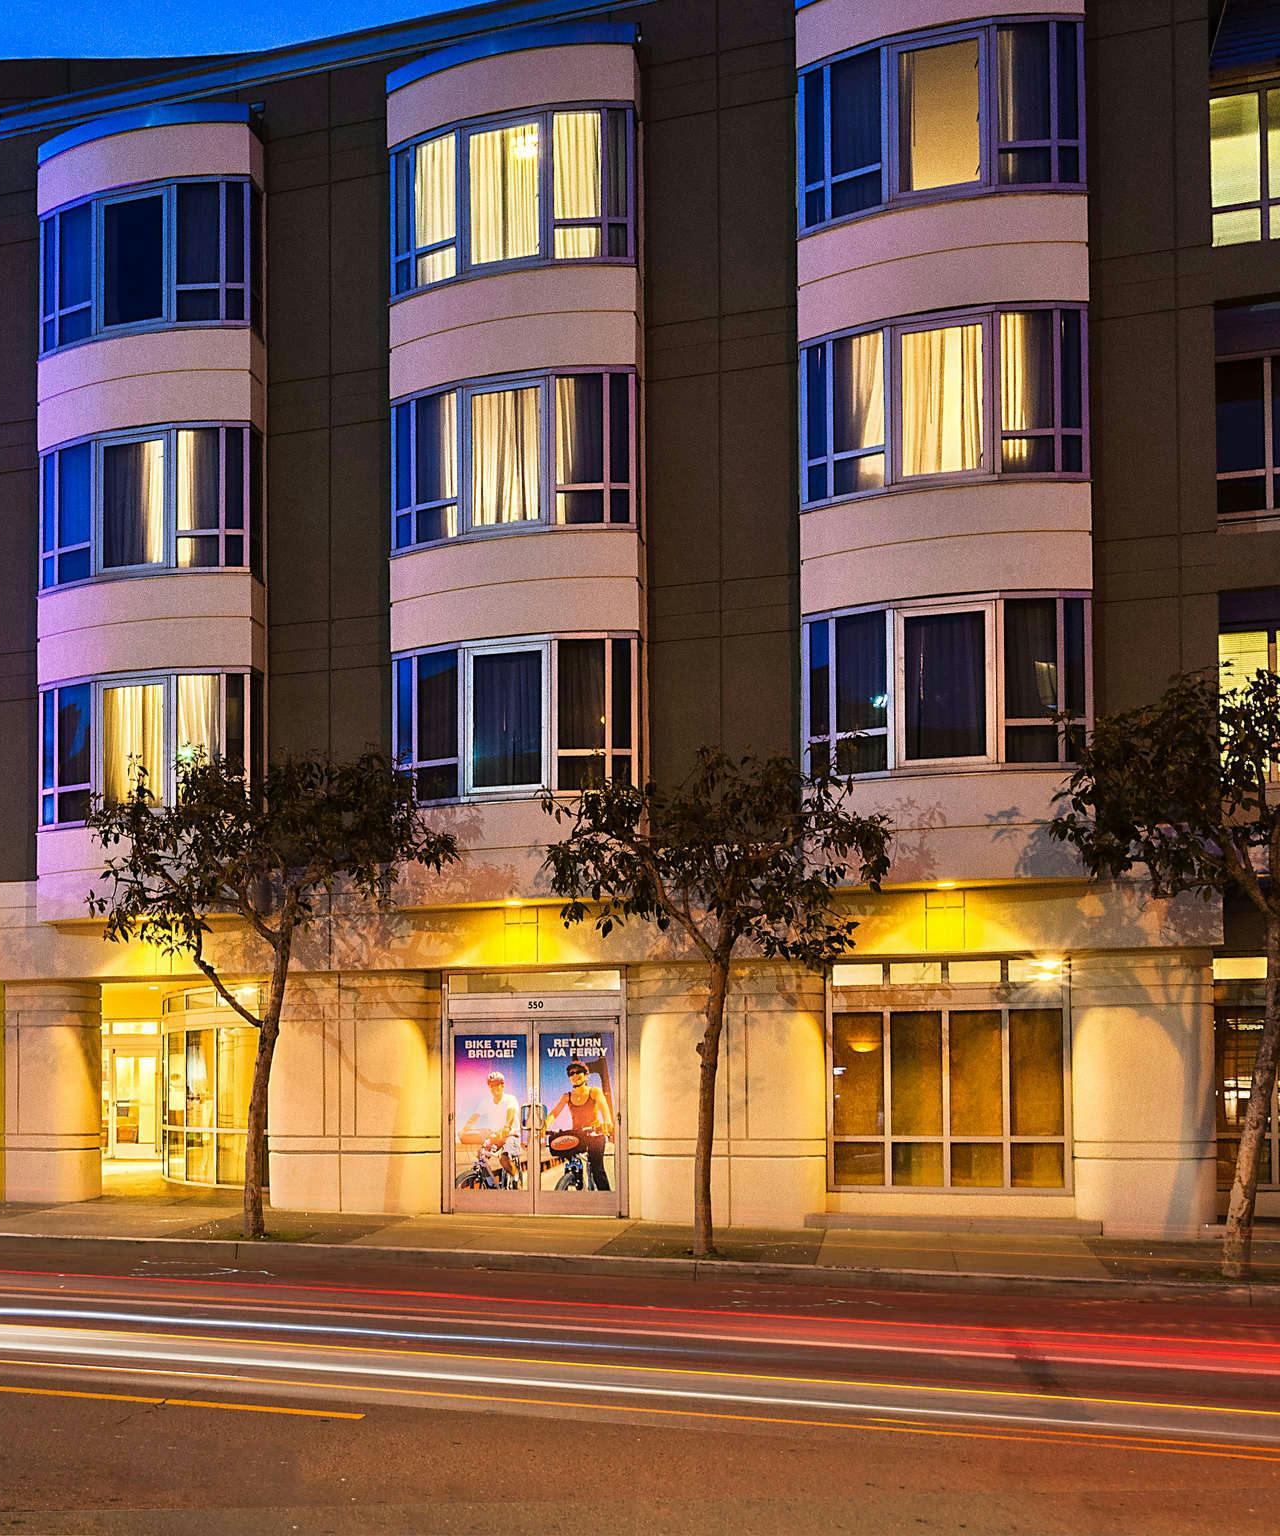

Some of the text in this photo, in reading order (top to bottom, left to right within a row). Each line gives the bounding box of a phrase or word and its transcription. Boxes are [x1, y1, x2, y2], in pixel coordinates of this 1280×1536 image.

[528, 1001, 544, 1009] 550
[465, 1040, 518, 1049] BIKE THE
[554, 1039, 601, 1048] RETURN
[468, 1049, 514, 1058] BRIDGE!
[548, 1048, 607, 1057] VIA FERRY
